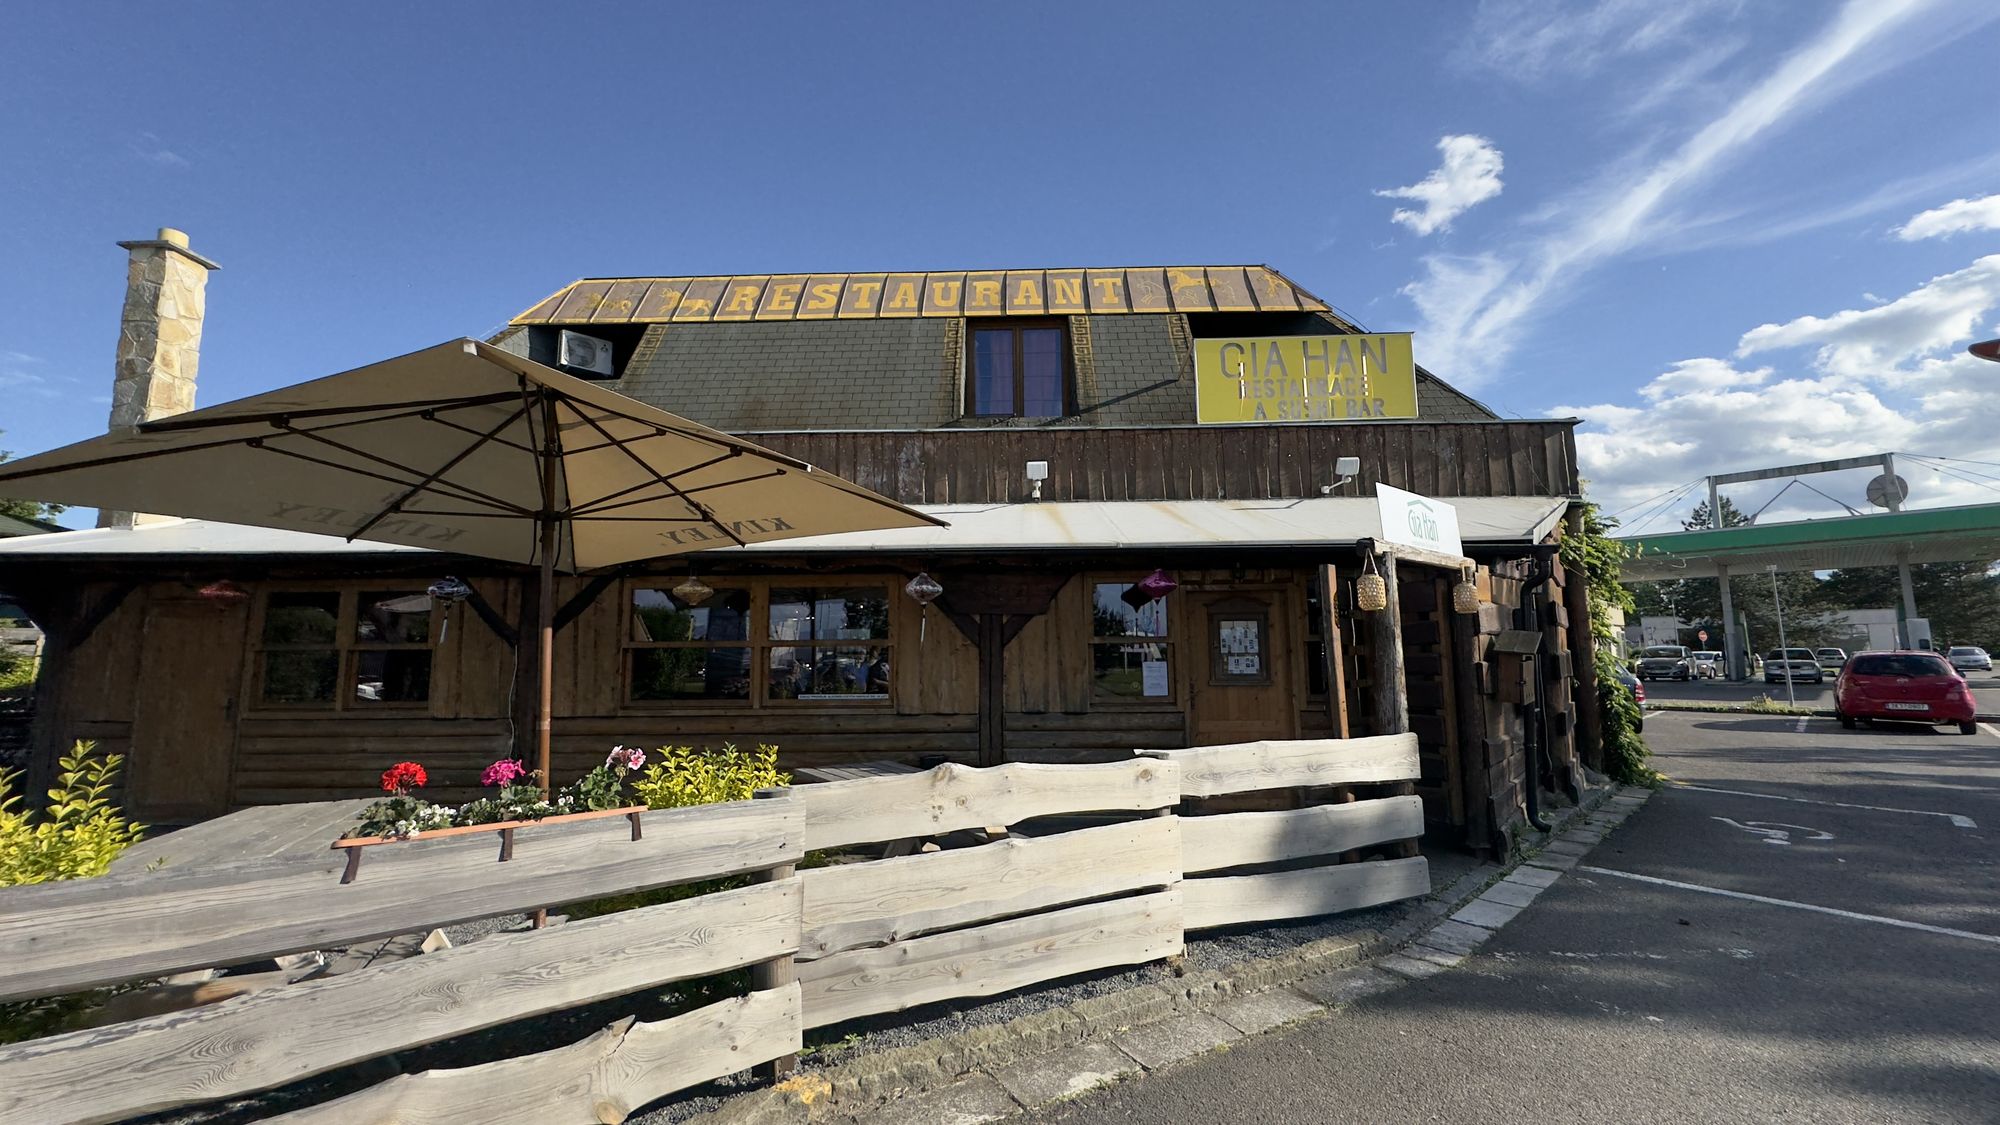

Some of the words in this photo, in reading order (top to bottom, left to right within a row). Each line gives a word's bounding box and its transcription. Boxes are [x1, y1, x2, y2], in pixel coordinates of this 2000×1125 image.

[725, 277, 1123, 313] RESTAURANT
[1219, 341, 1288, 379] GIA
[1302, 337, 1387, 376] HAN
[1253, 400, 1268, 420] A
[1277, 398, 1335, 419] SUSHI
[1346, 397, 1387, 418] BAR
[1422, 511, 1439, 543] Han
